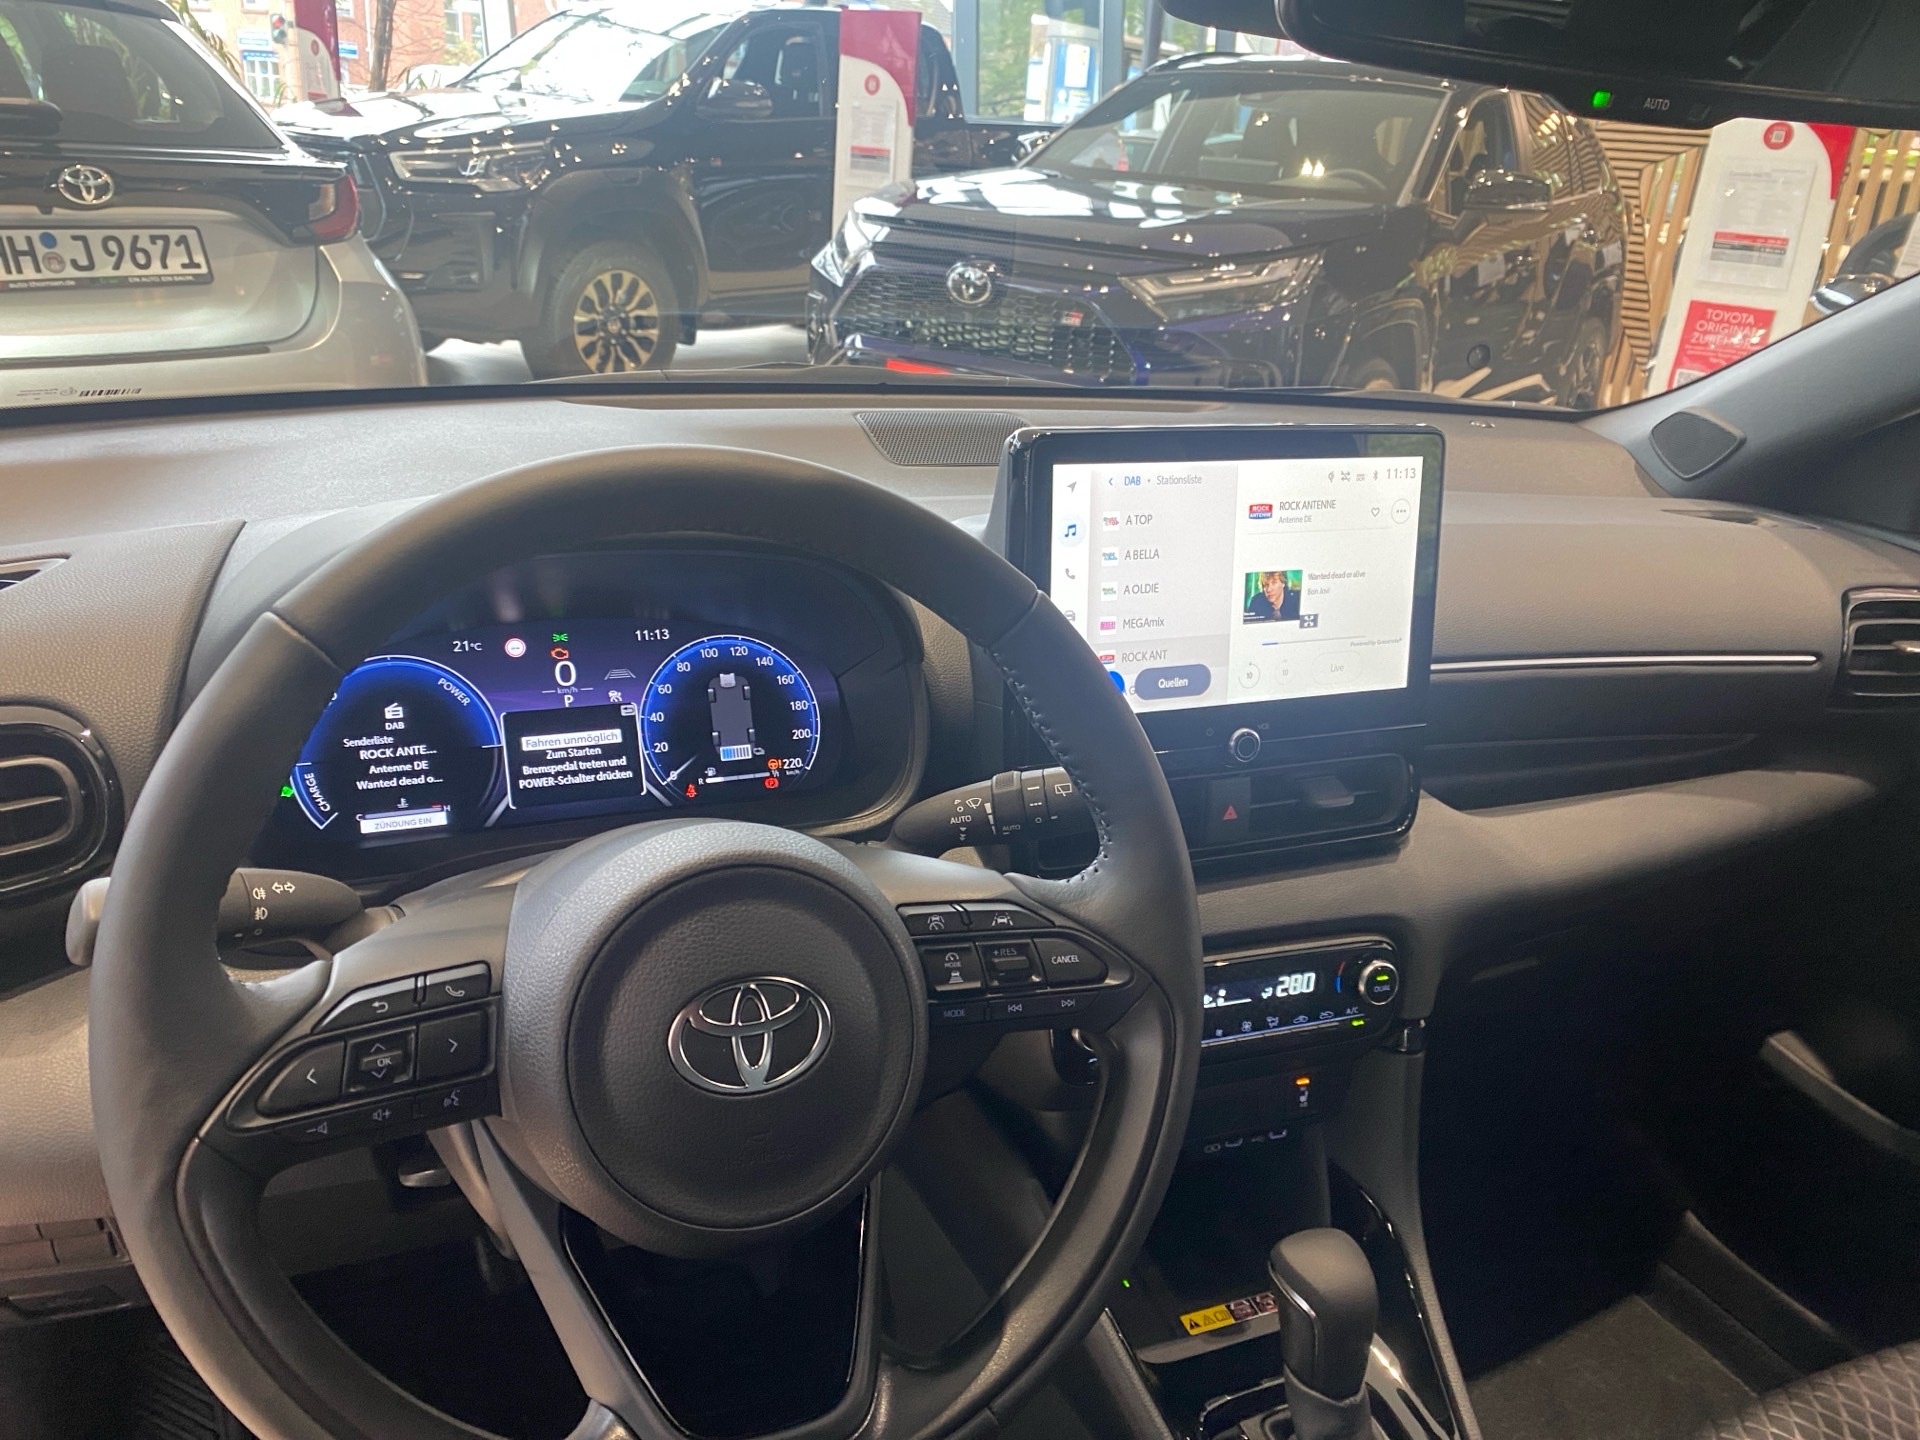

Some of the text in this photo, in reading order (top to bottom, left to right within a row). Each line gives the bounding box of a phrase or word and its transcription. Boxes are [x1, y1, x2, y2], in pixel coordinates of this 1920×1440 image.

[1643, 97, 1671, 111] AUTO
[69, 234, 96, 272] J
[101, 234, 202, 271] 9671
[1705, 308, 1756, 325] TOYOTA
[1386, 467, 1417, 480] 11:13
[1124, 474, 1203, 486] DAB Stationsliste
[1251, 504, 1271, 512] ROCK
[1279, 499, 1337, 511] ROCK ANTENNE
[1125, 515, 1133, 526] A
[1134, 514, 1153, 525] TOP
[1278, 515, 1312, 524] Antenne DE
[1124, 550, 1132, 561] A
[1132, 549, 1160, 560] BELLA
[1307, 572, 1331, 581] Wanted
[1331, 571, 1346, 580] dead
[1123, 584, 1131, 595] A
[1131, 583, 1160, 594] OLDIE
[1122, 616, 1165, 630] MEGAmix
[635, 628, 670, 641] 11:13
[700, 647, 719, 658] 100
[729, 645, 748, 657] 120
[1121, 651, 1149, 663] ROCK
[1149, 649, 1168, 661] ANT
[676, 661, 691, 672] 80
[755, 656, 774, 667] 140
[1330, 662, 1345, 673] Live
[554, 660, 577, 687] 0
[776, 674, 795, 685] 160
[658, 682, 673, 694] 60
[1158, 677, 1189, 689] Quellen
[437, 677, 471, 707] POWER
[557, 685, 579, 695] km/h
[564, 694, 574, 707] P
[789, 700, 808, 711] 180
[650, 711, 665, 723] 40
[385, 721, 405, 731] DAB
[525, 731, 618, 749] Fahren unmöglich
[792, 728, 811, 740] 200
[343, 735, 394, 748] Senderliste
[653, 742, 669, 753] 20
[359, 745, 437, 761] ROCK ANTE...
[546, 747, 602, 760] Zum Starten
[369, 760, 429, 775] Antenne DE
[522, 755, 627, 776] Bremspedal treten und
[782, 757, 802, 769] 220
[356, 778, 397, 791] Wanted
[398, 775, 425, 788] dead
[518, 769, 633, 789] POWER-Schalter drücken
[698, 778, 705, 786] R
[303, 772, 331, 812] CHARGE
[374, 816, 432, 831] ZÜNDUNG EIN
[950, 815, 972, 825] AUTO
[1051, 954, 1080, 965] CANCEL
[943, 1009, 966, 1018] MODE
[1345, 1006, 1359, 1015] A/C
[377, 1057, 392, 1067] OK
